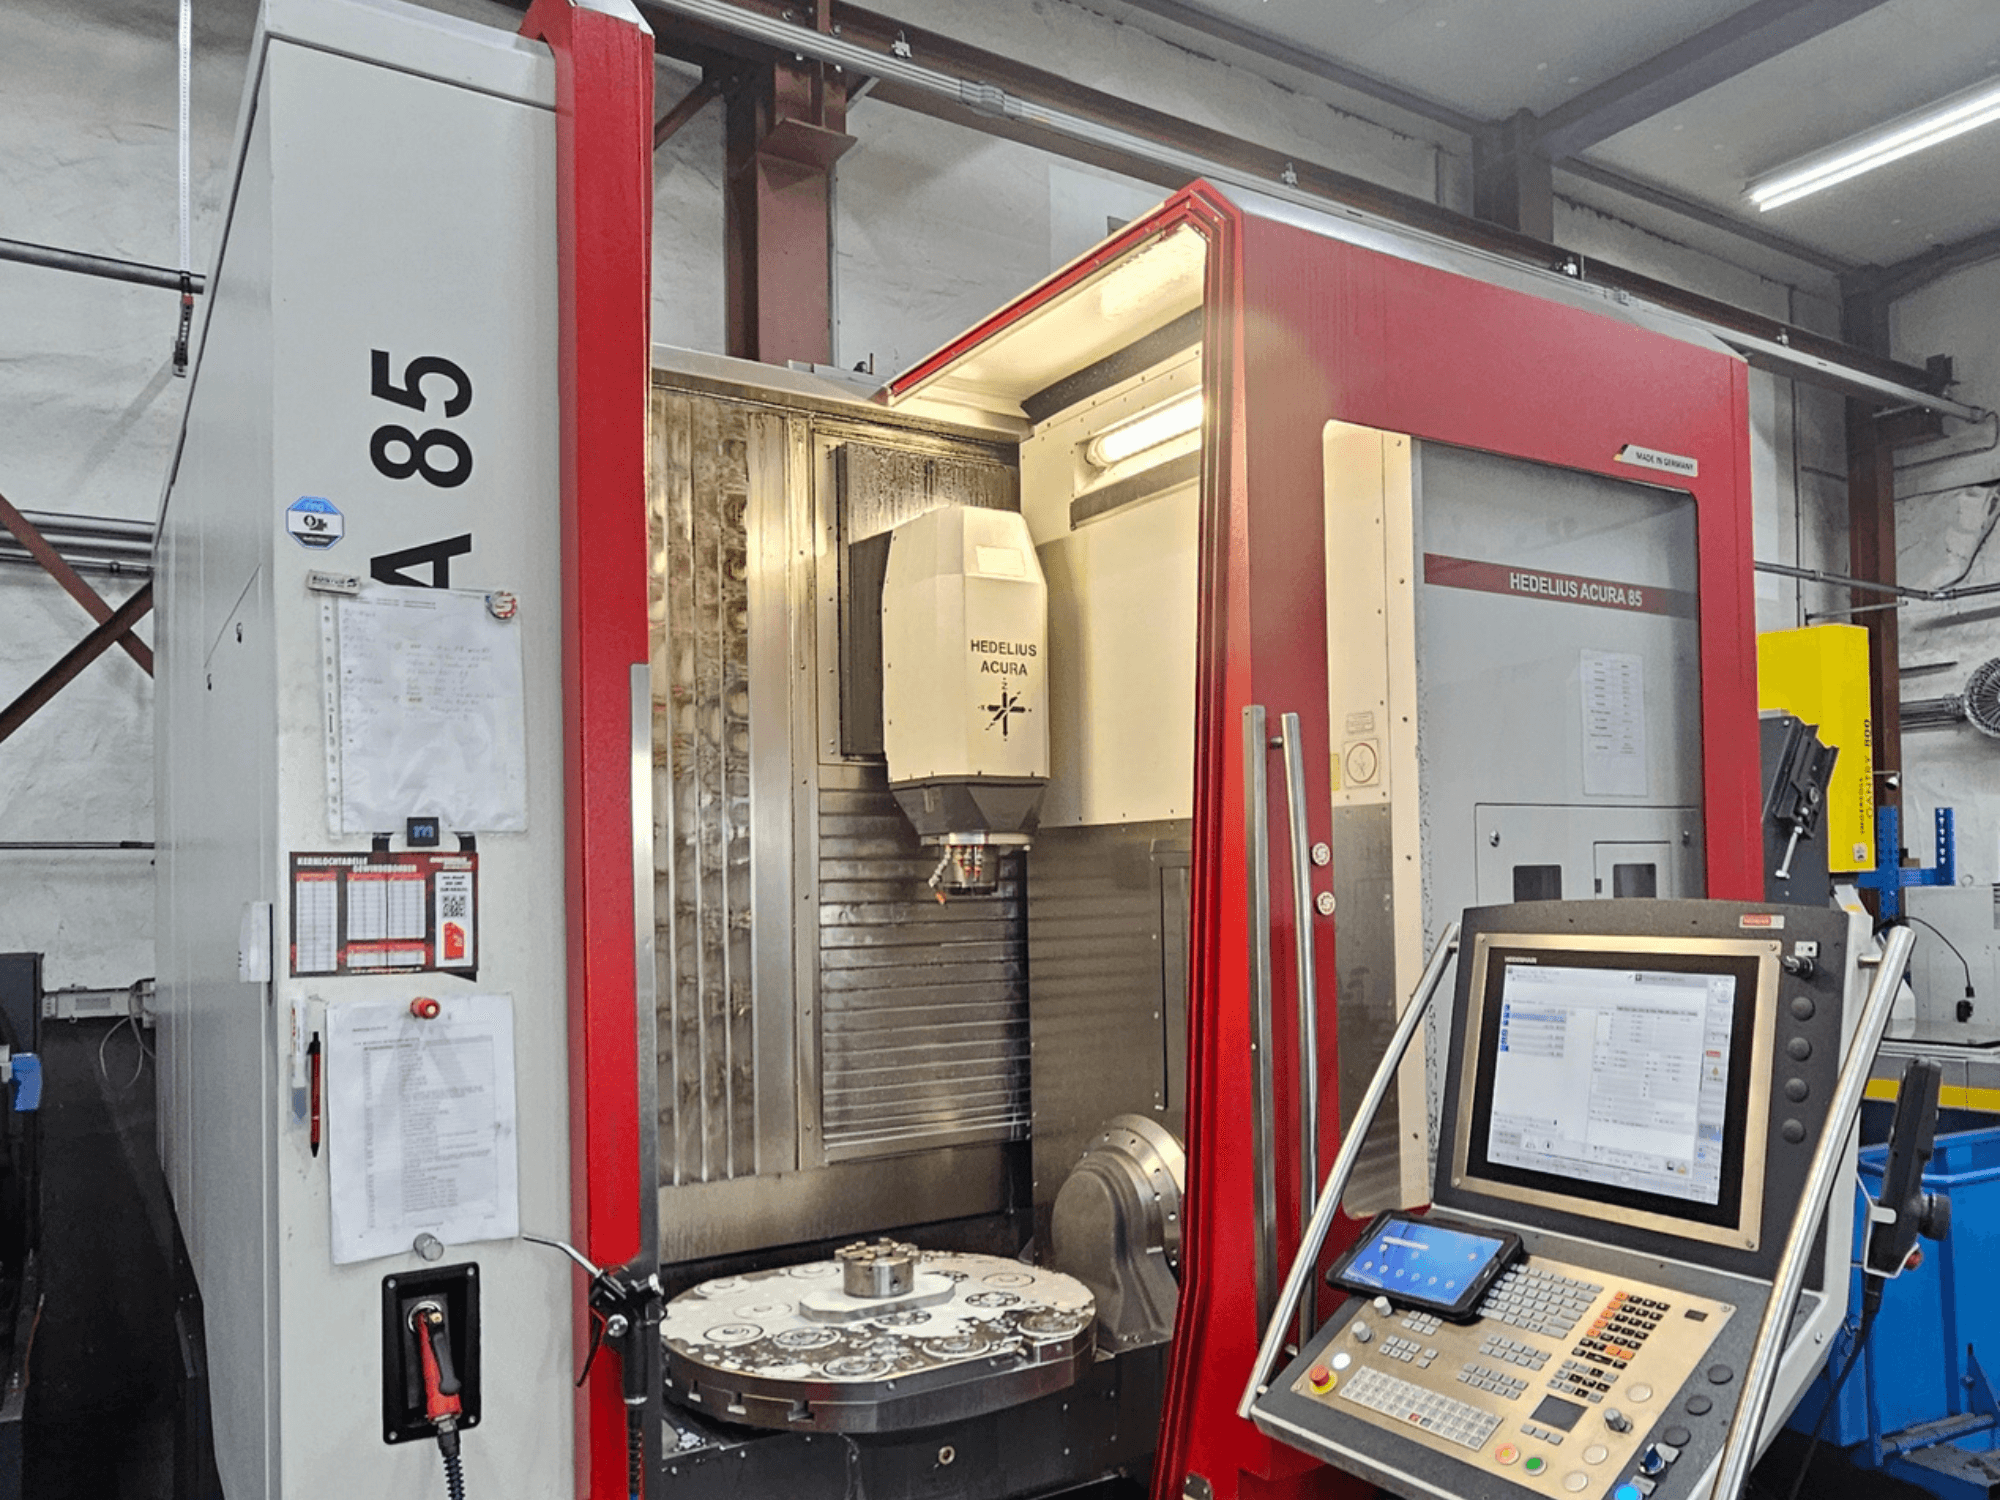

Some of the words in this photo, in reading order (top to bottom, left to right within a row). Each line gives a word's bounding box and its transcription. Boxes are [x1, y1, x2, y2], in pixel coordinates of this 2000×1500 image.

[370, 349, 473, 488] 85
[1635, 451, 1655, 464] MADE
[1656, 456, 1663, 465] IN
[1663, 457, 1693, 471] GERMANY
[1509, 572, 1578, 598] HEDELIUS
[1579, 583, 1627, 605] ACURA
[1628, 590, 1643, 607] 85
[970, 639, 1037, 657] HEDELIUS
[980, 660, 1028, 677] ACURA
